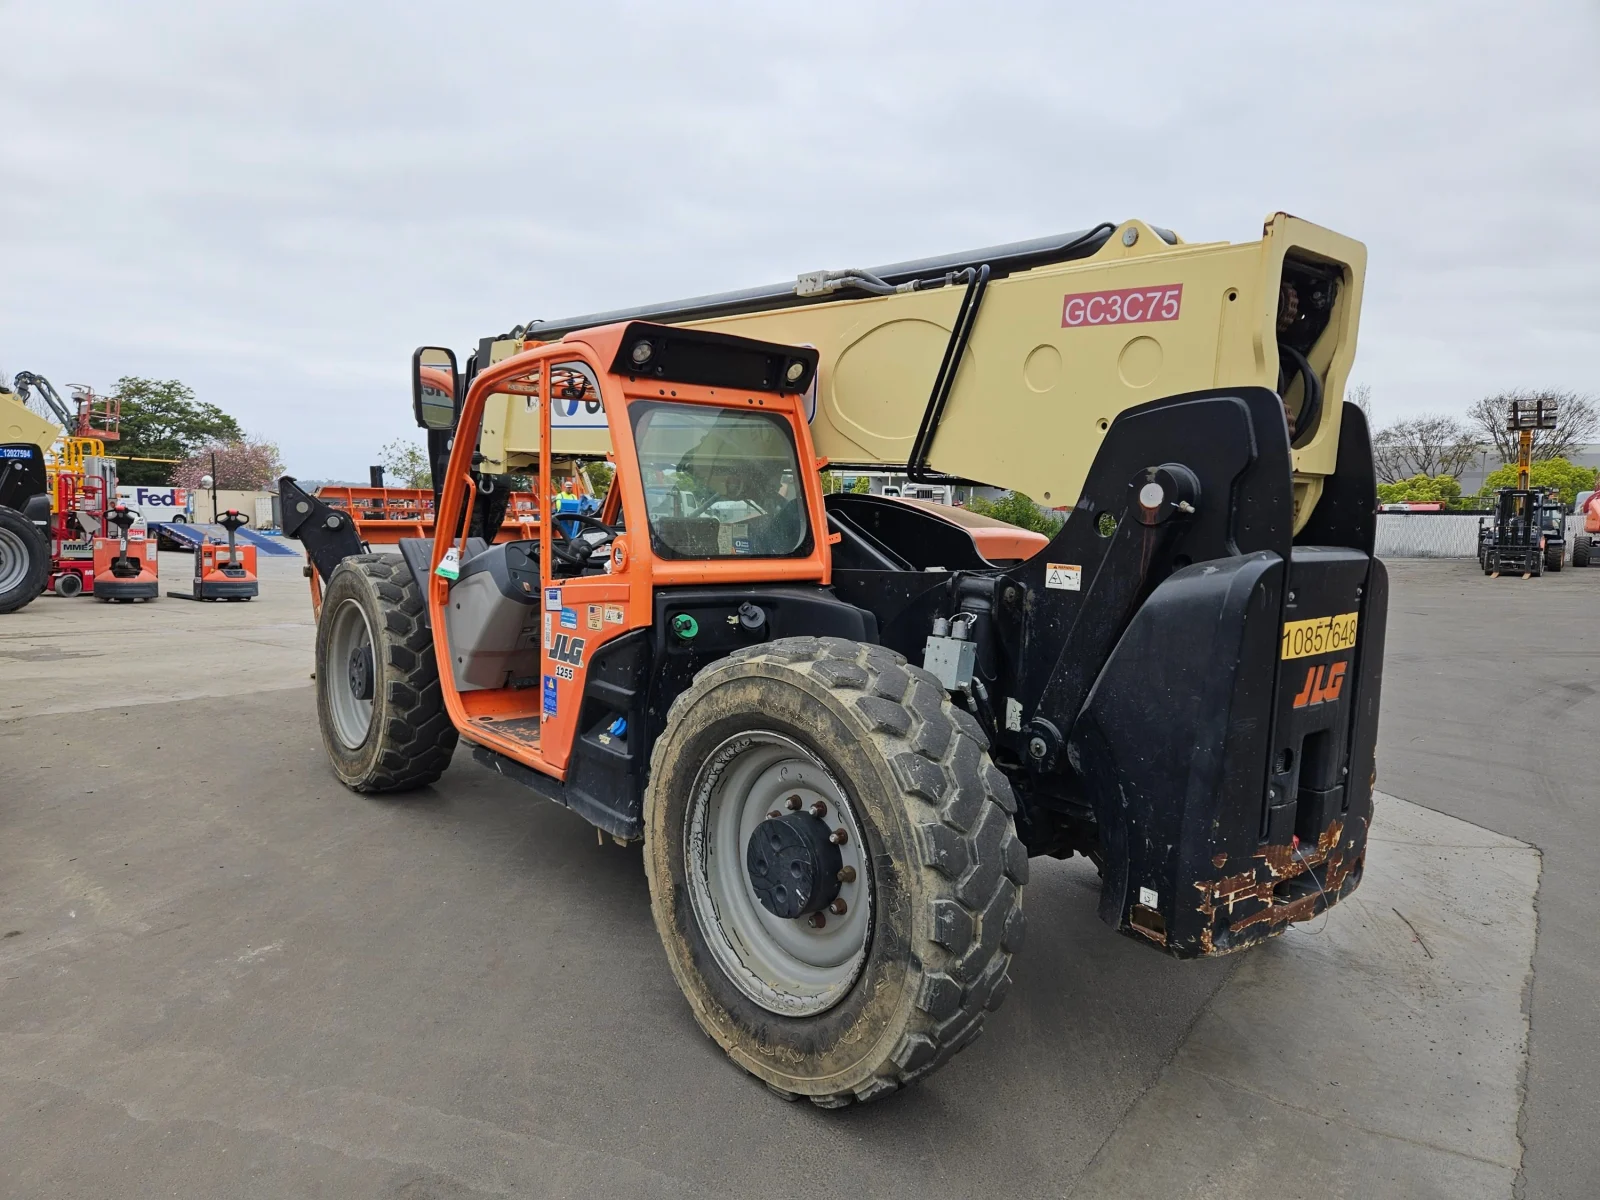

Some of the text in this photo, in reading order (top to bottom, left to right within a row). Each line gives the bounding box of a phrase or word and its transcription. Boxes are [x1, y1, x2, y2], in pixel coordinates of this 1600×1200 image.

[1065, 290, 1179, 325] GC3C75
[137, 488, 187, 507] FedE
[548, 633, 586, 667] JLG
[1282, 619, 1356, 657] 10857648
[556, 666, 573, 679] 1255
[1293, 660, 1348, 709] JLG
